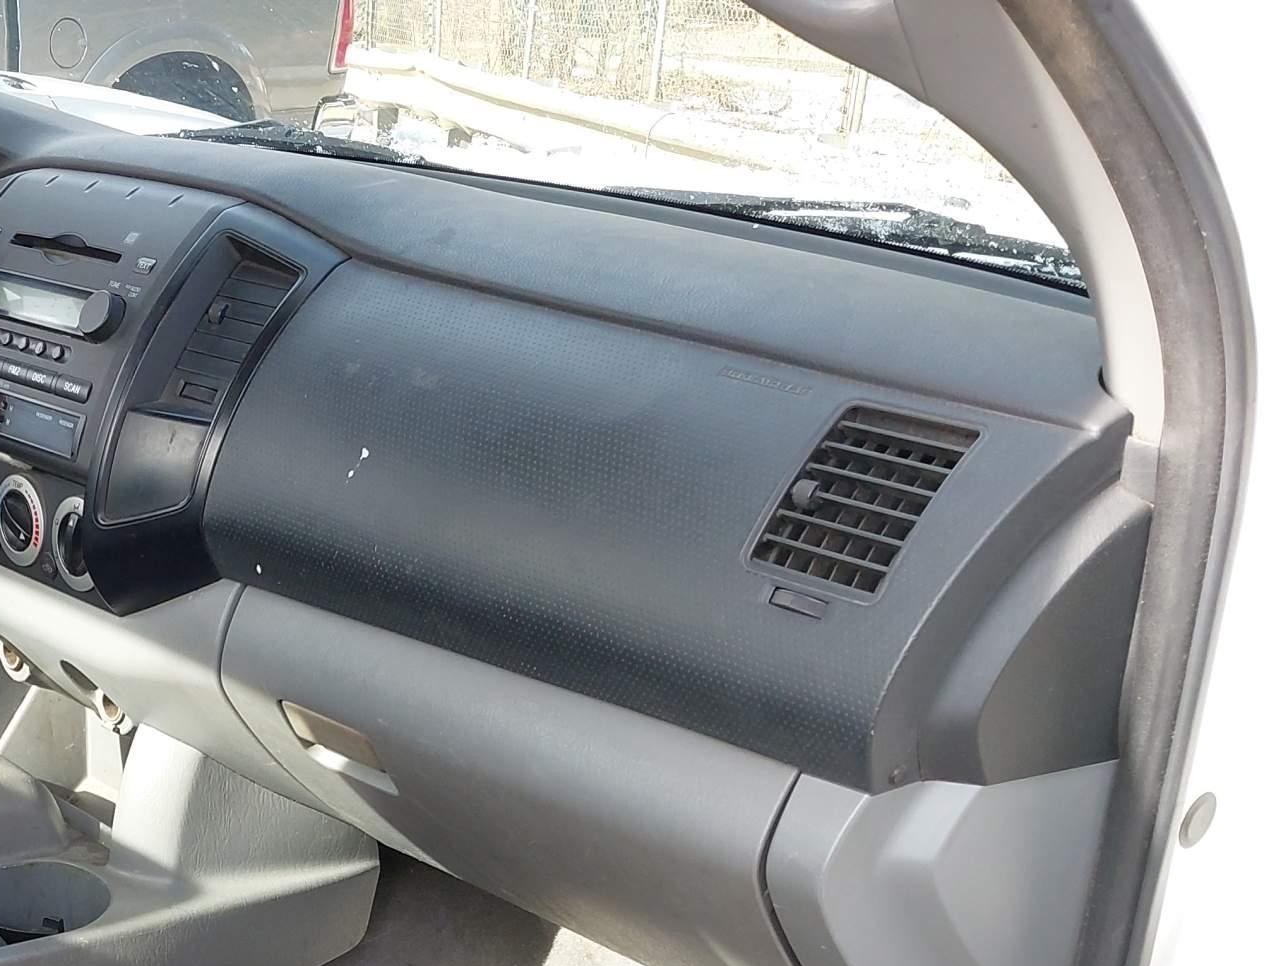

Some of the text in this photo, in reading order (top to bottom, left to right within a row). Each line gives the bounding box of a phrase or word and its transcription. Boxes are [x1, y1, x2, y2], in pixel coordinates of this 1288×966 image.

[8, 365, 20, 377] FM2
[31, 372, 47, 385] DISC
[63, 381, 81, 395] SCAN
